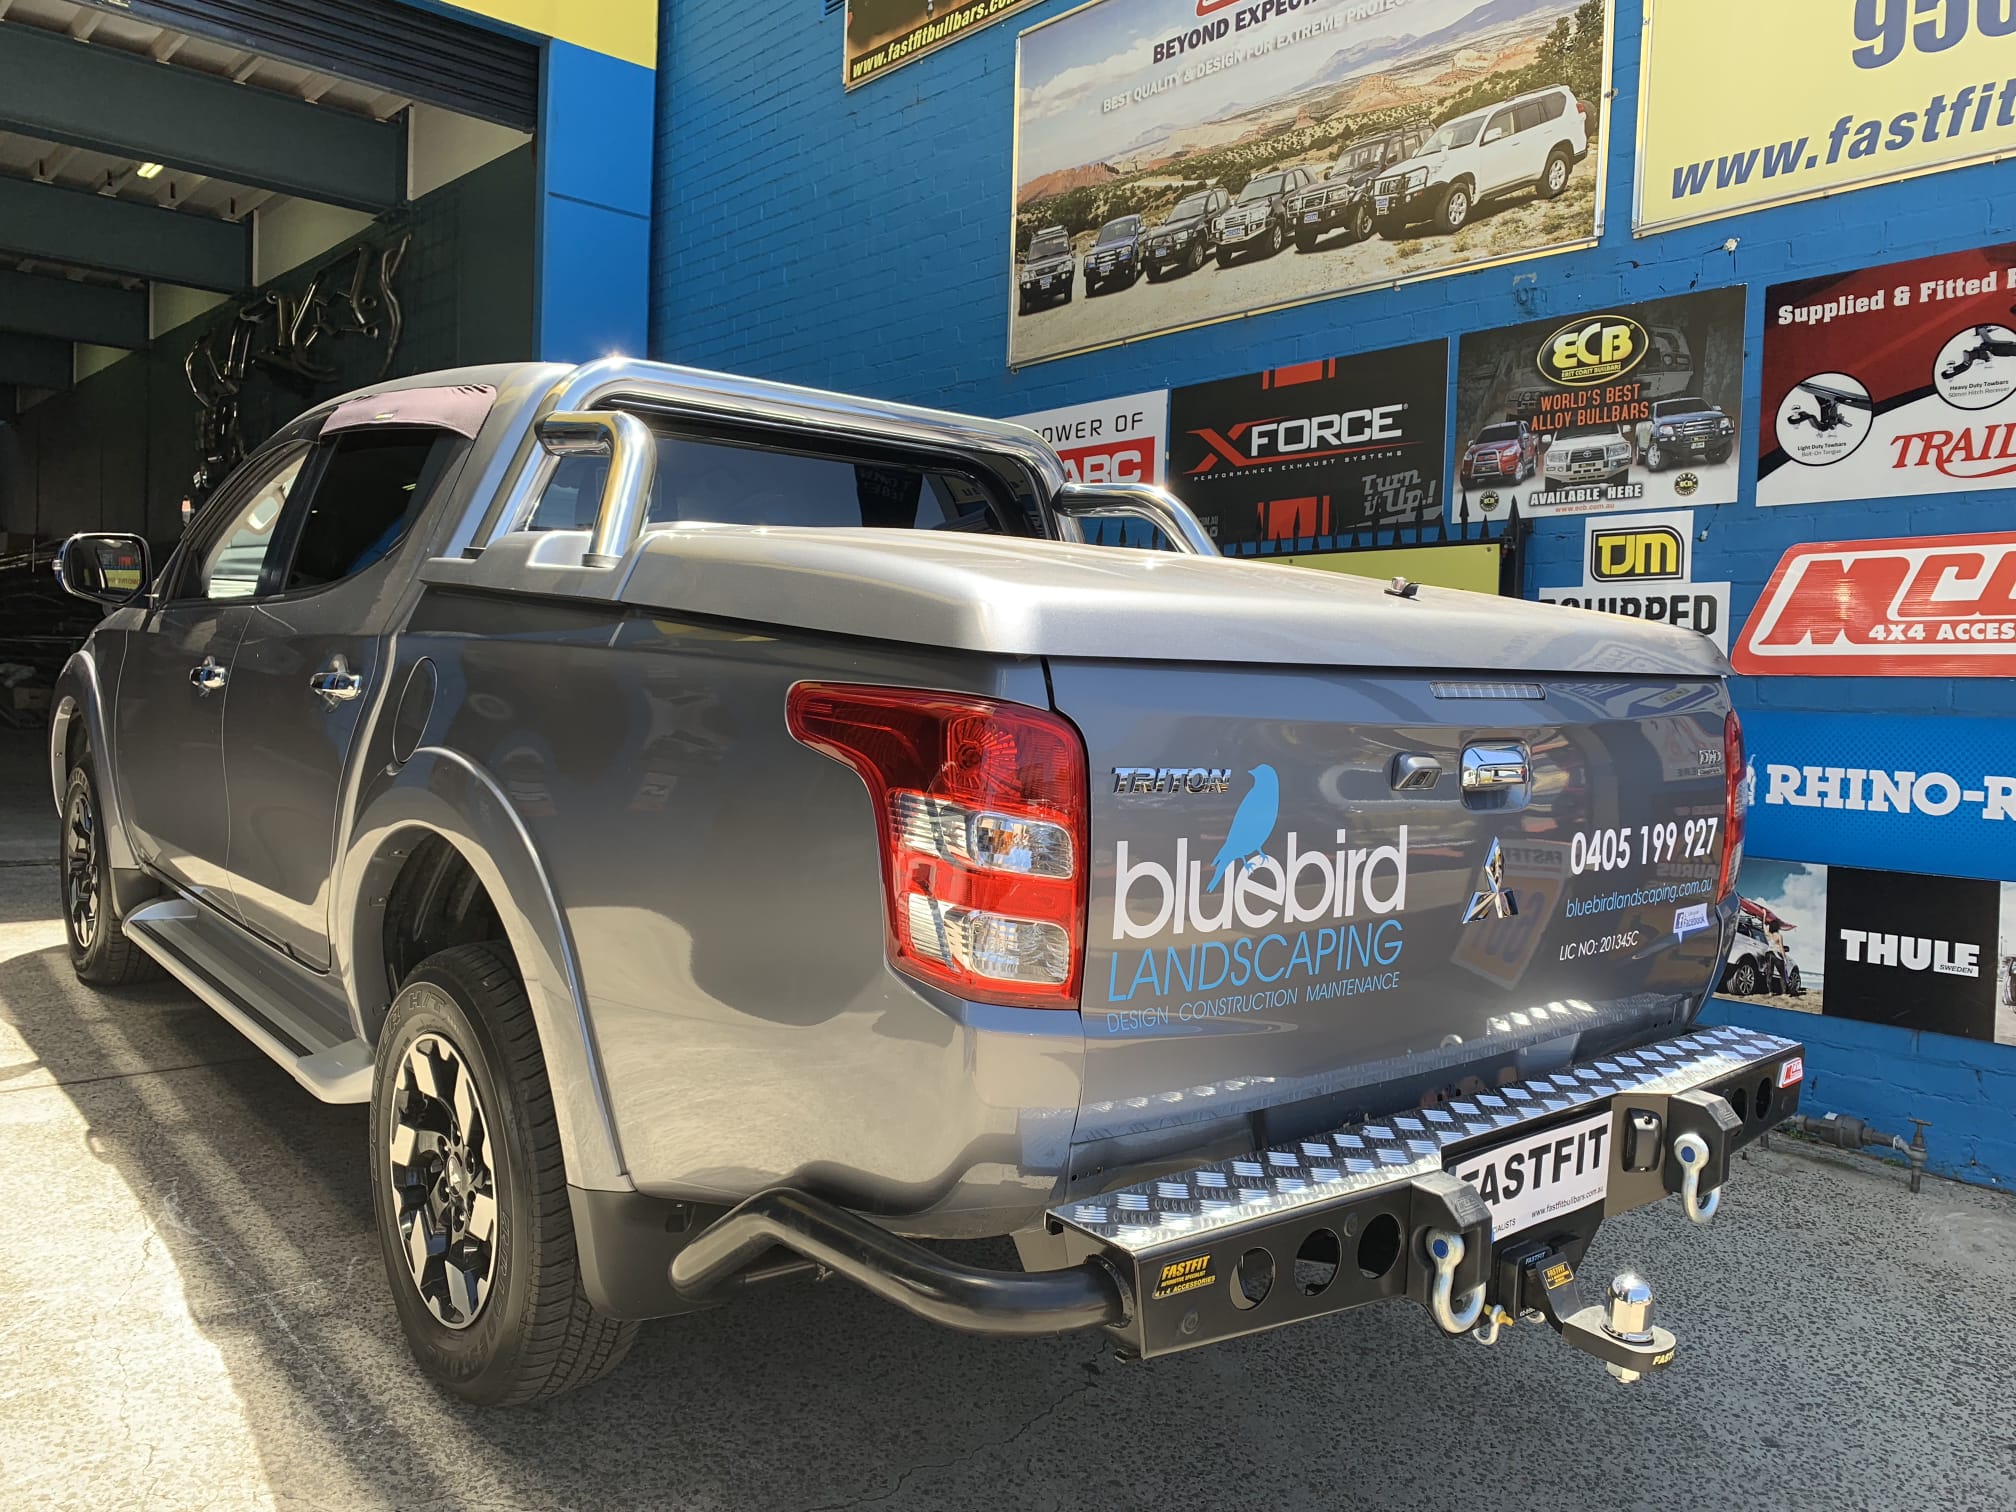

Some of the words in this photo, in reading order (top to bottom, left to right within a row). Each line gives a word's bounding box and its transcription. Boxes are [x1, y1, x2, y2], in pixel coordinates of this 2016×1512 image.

[1153, 17, 1229, 64] BEYOND
[1235, 0, 1317, 32] EXPEC
[1103, 91, 1131, 113] BEST
[1134, 72, 1181, 102] QUALITY
[1183, 68, 1196, 83] &
[1196, 50, 1242, 77] DESIGN
[1246, 39, 1272, 60] FOR
[1276, 14, 1346, 49] EXTREME
[1672, 78, 2016, 199] www.fastfit
[1778, 290, 1884, 325] Supplied
[1893, 285, 1911, 306] &
[1920, 270, 1998, 303] Fitted
[1553, 322, 1633, 368] ECB
[1531, 411, 1572, 432] ALLOY
[1577, 401, 1649, 426] BULLBARS
[1541, 389, 1601, 412] WORLD'S
[1606, 383, 1640, 403] BEST
[1036, 419, 1102, 443] OWER
[1115, 411, 1143, 433] OF
[1183, 403, 1403, 475] XFORCE
[1193, 466, 1273, 482] PERFORMANCE
[1281, 458, 1336, 471] EXHAUST
[1344, 450, 1403, 463] SYSTEMS
[1362, 469, 1421, 496] Turn
[1530, 487, 1601, 507] AVAILABLE
[1607, 484, 1643, 500] HERE
[1597, 532, 1678, 576] TJM
[1936, 622, 2016, 640] ACCES
[1111, 766, 1232, 795] TRITON
[1766, 763, 2016, 822] RHINO-R
[1570, 828, 1632, 876] 0405
[1639, 821, 1678, 865] 199
[1683, 816, 1719, 860] 927
[1112, 824, 1409, 940] bluebird
[1565, 876, 1713, 919] bluebirdlandscaping.com.au
[1108, 919, 1404, 1003] LANDSCAPING
[1559, 944, 1577, 961] LIC
[1578, 937, 1599, 957] NO:
[1599, 930, 1640, 953] 201345C
[1840, 928, 1981, 978] THULE
[1938, 963, 1974, 974] SWEDEN
[1106, 1005, 1169, 1033] DESIGN
[1179, 987, 1298, 1022] CONSTRUCTION
[1305, 971, 1401, 1002] MAINTENANCE
[1531, 1186, 1604, 1218] www.fastfitbullbars.com.au
[1162, 1255, 1211, 1281] FASTFIT
[1173, 1274, 1216, 1293] ACCESSORIES
